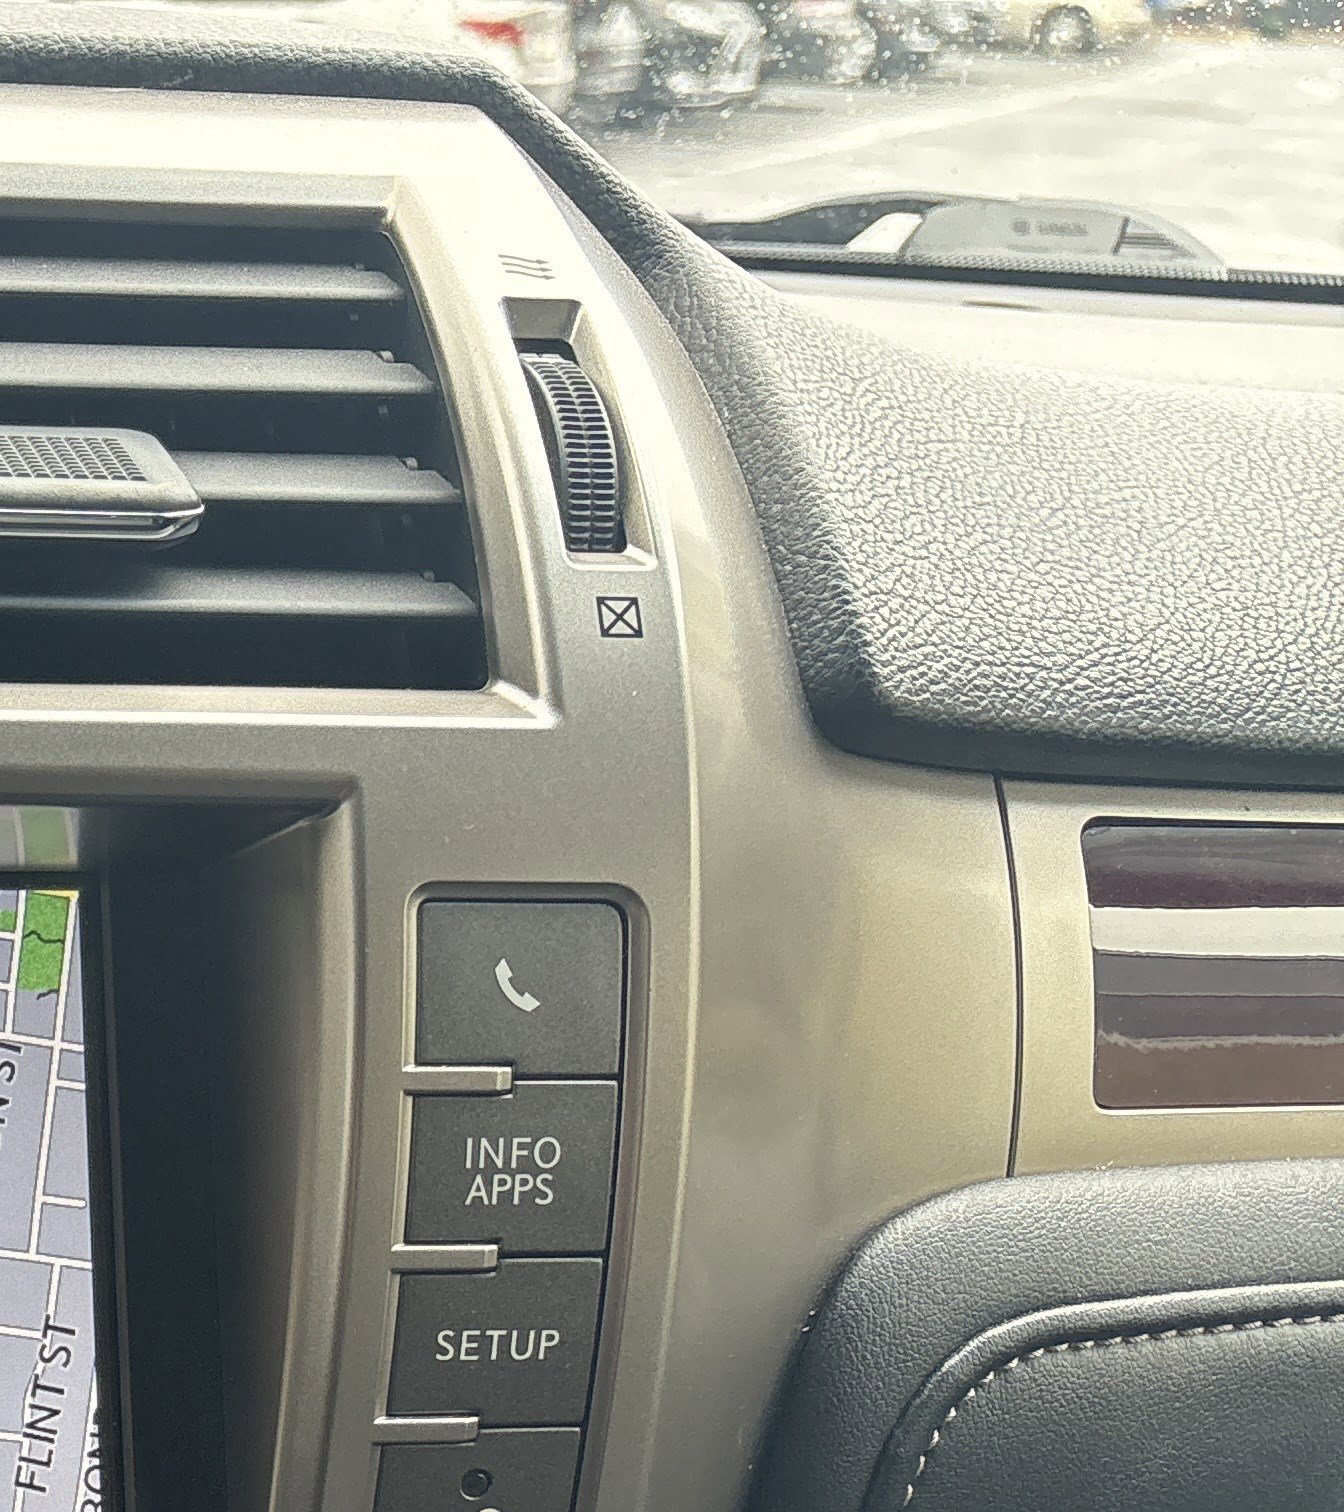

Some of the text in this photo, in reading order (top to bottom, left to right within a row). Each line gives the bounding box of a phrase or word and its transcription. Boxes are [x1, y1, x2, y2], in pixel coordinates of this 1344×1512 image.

[465, 1136, 562, 1170] INFO
[465, 1173, 555, 1206] APPS
[435, 1329, 560, 1361] SETUP
[17, 1314, 77, 1493] FLINT ST
